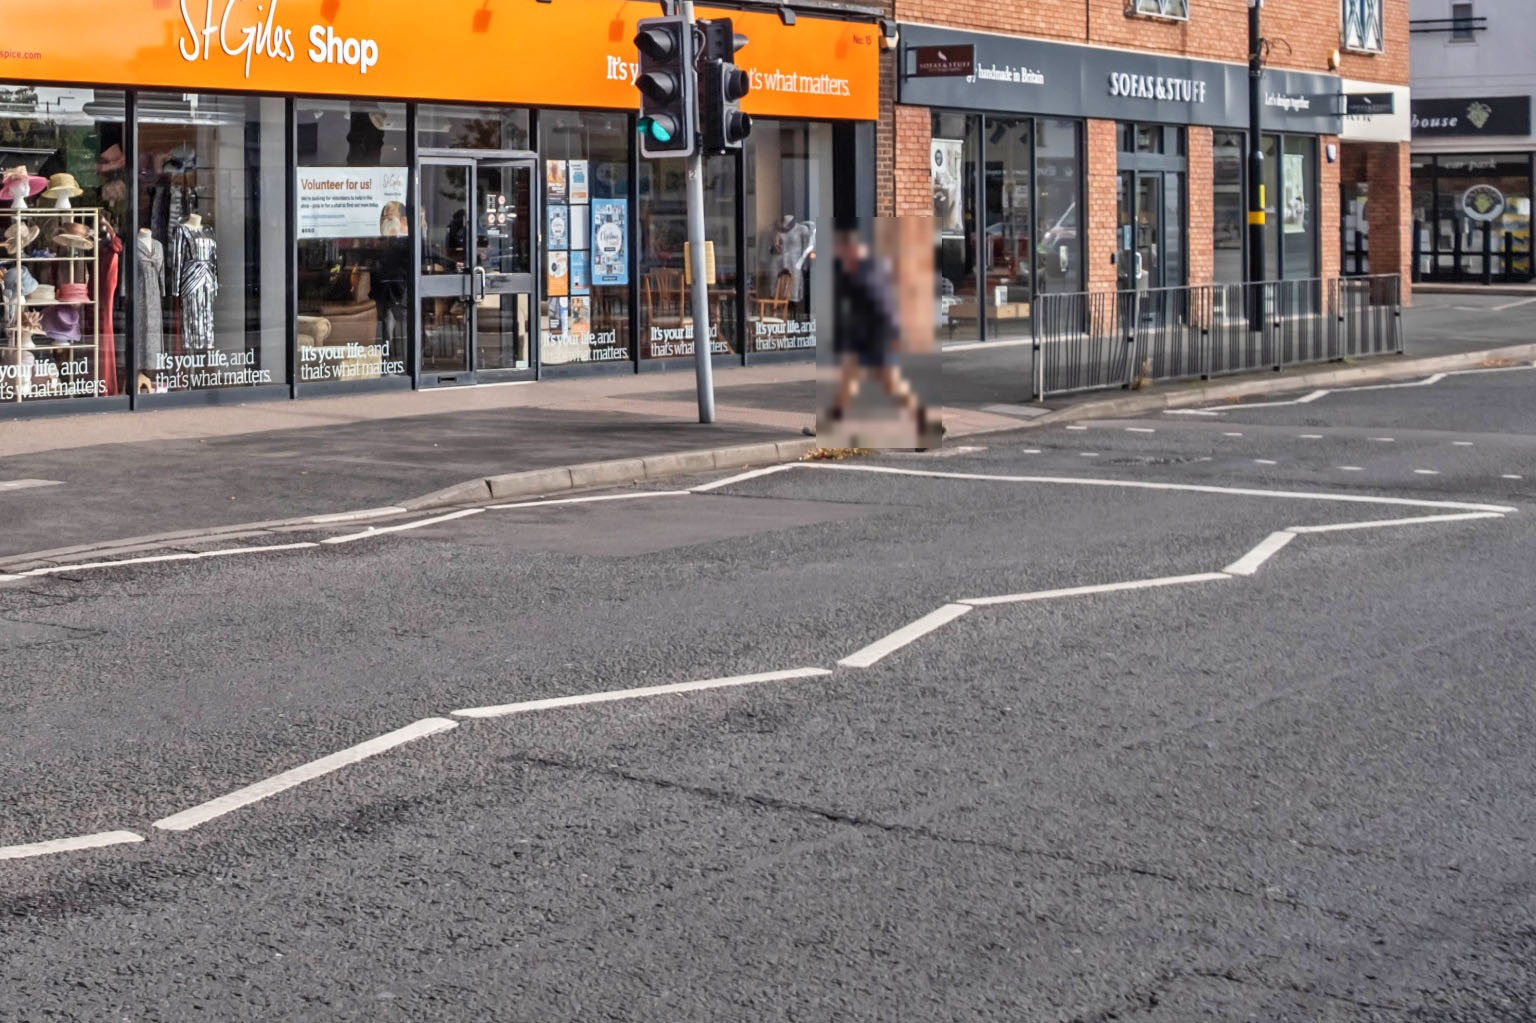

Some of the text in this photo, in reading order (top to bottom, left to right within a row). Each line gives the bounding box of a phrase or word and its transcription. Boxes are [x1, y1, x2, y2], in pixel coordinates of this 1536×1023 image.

[308, 24, 379, 74] Shop
[607, 55, 628, 80] It's
[1013, 67, 1020, 82] in
[1021, 66, 1044, 84] Britain
[749, 67, 851, 96] t's what matters.
[301, 178, 373, 190] Volunteer for us!
[598, 329, 616, 344] and
[651, 326, 663, 341] It's
[664, 327, 684, 343] your
[767, 322, 786, 336] your
[301, 340, 390, 363] It's your life, and
[651, 342, 673, 357] that's
[674, 340, 695, 355] what
[777, 335, 796, 348] what
[156, 348, 255, 372] It's your life, and
[593, 346, 629, 361] matters.
[35, 359, 59, 378] life,
[61, 357, 89, 375] and
[301, 359, 405, 380] that's what matters.
[15, 379, 52, 399] what
[53, 377, 109, 396] matters.
[156, 368, 272, 389] that's what matters.
